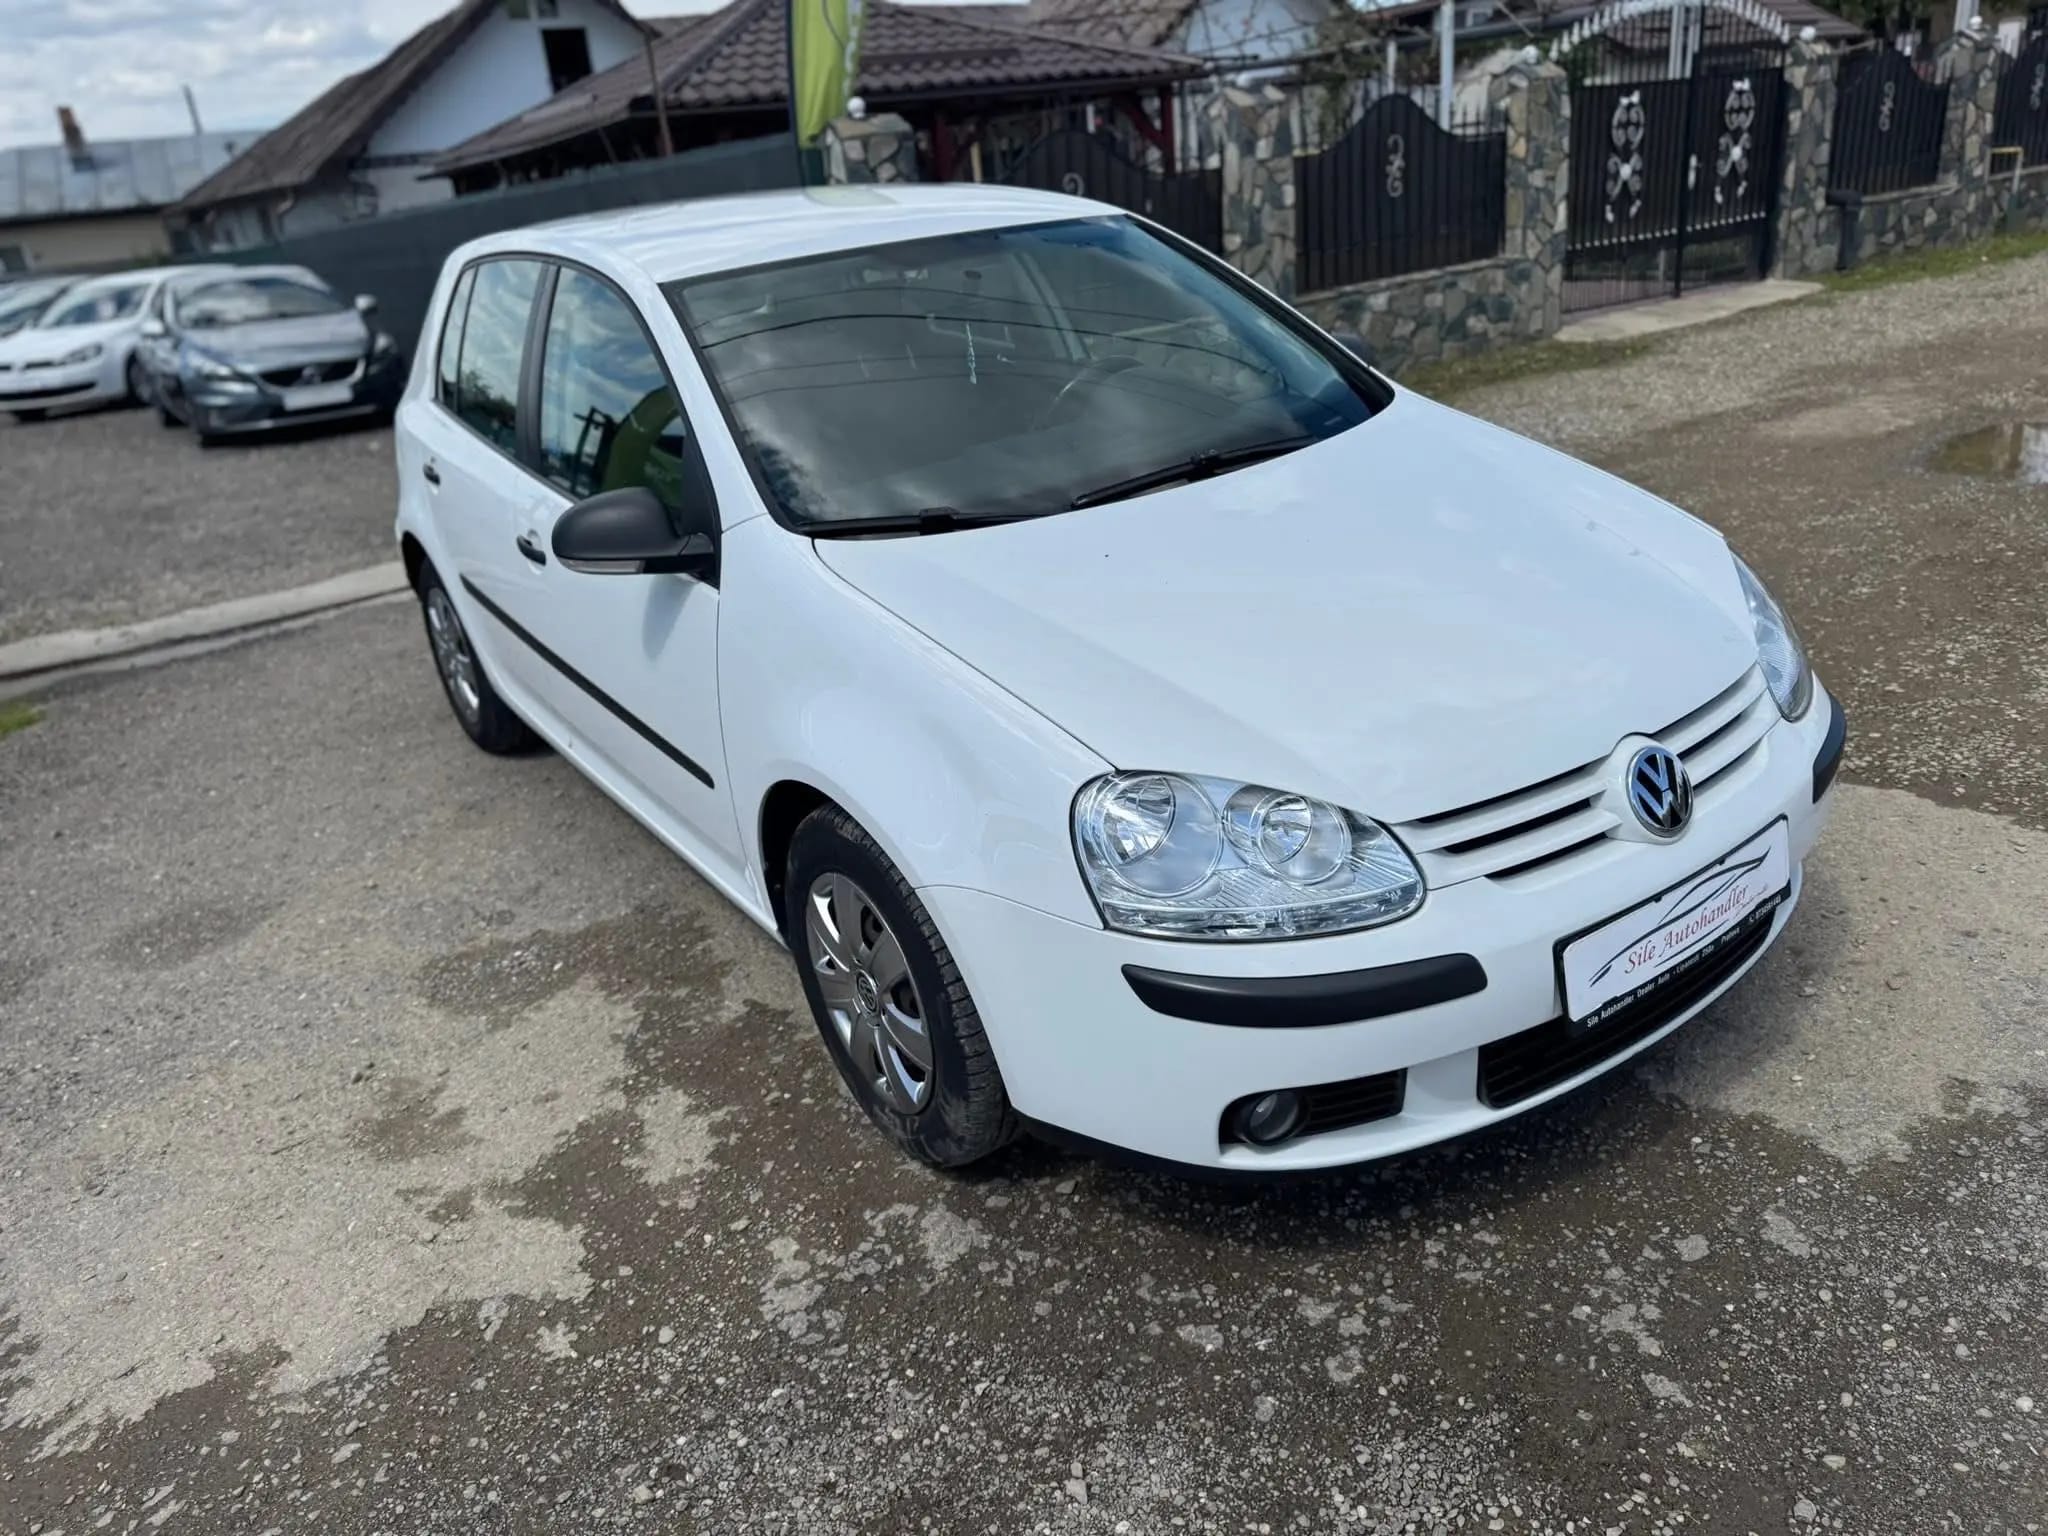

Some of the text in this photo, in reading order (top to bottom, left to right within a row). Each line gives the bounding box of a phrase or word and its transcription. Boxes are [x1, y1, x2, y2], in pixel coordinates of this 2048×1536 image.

[1628, 747, 1692, 833] VW
[1625, 940, 1657, 975] Sile
[1659, 884, 1749, 958] Autohandler
[1587, 1015, 1599, 1028] Sile
[1600, 995, 1635, 1020] Autohandler
[1637, 983, 1655, 998] Dealer
